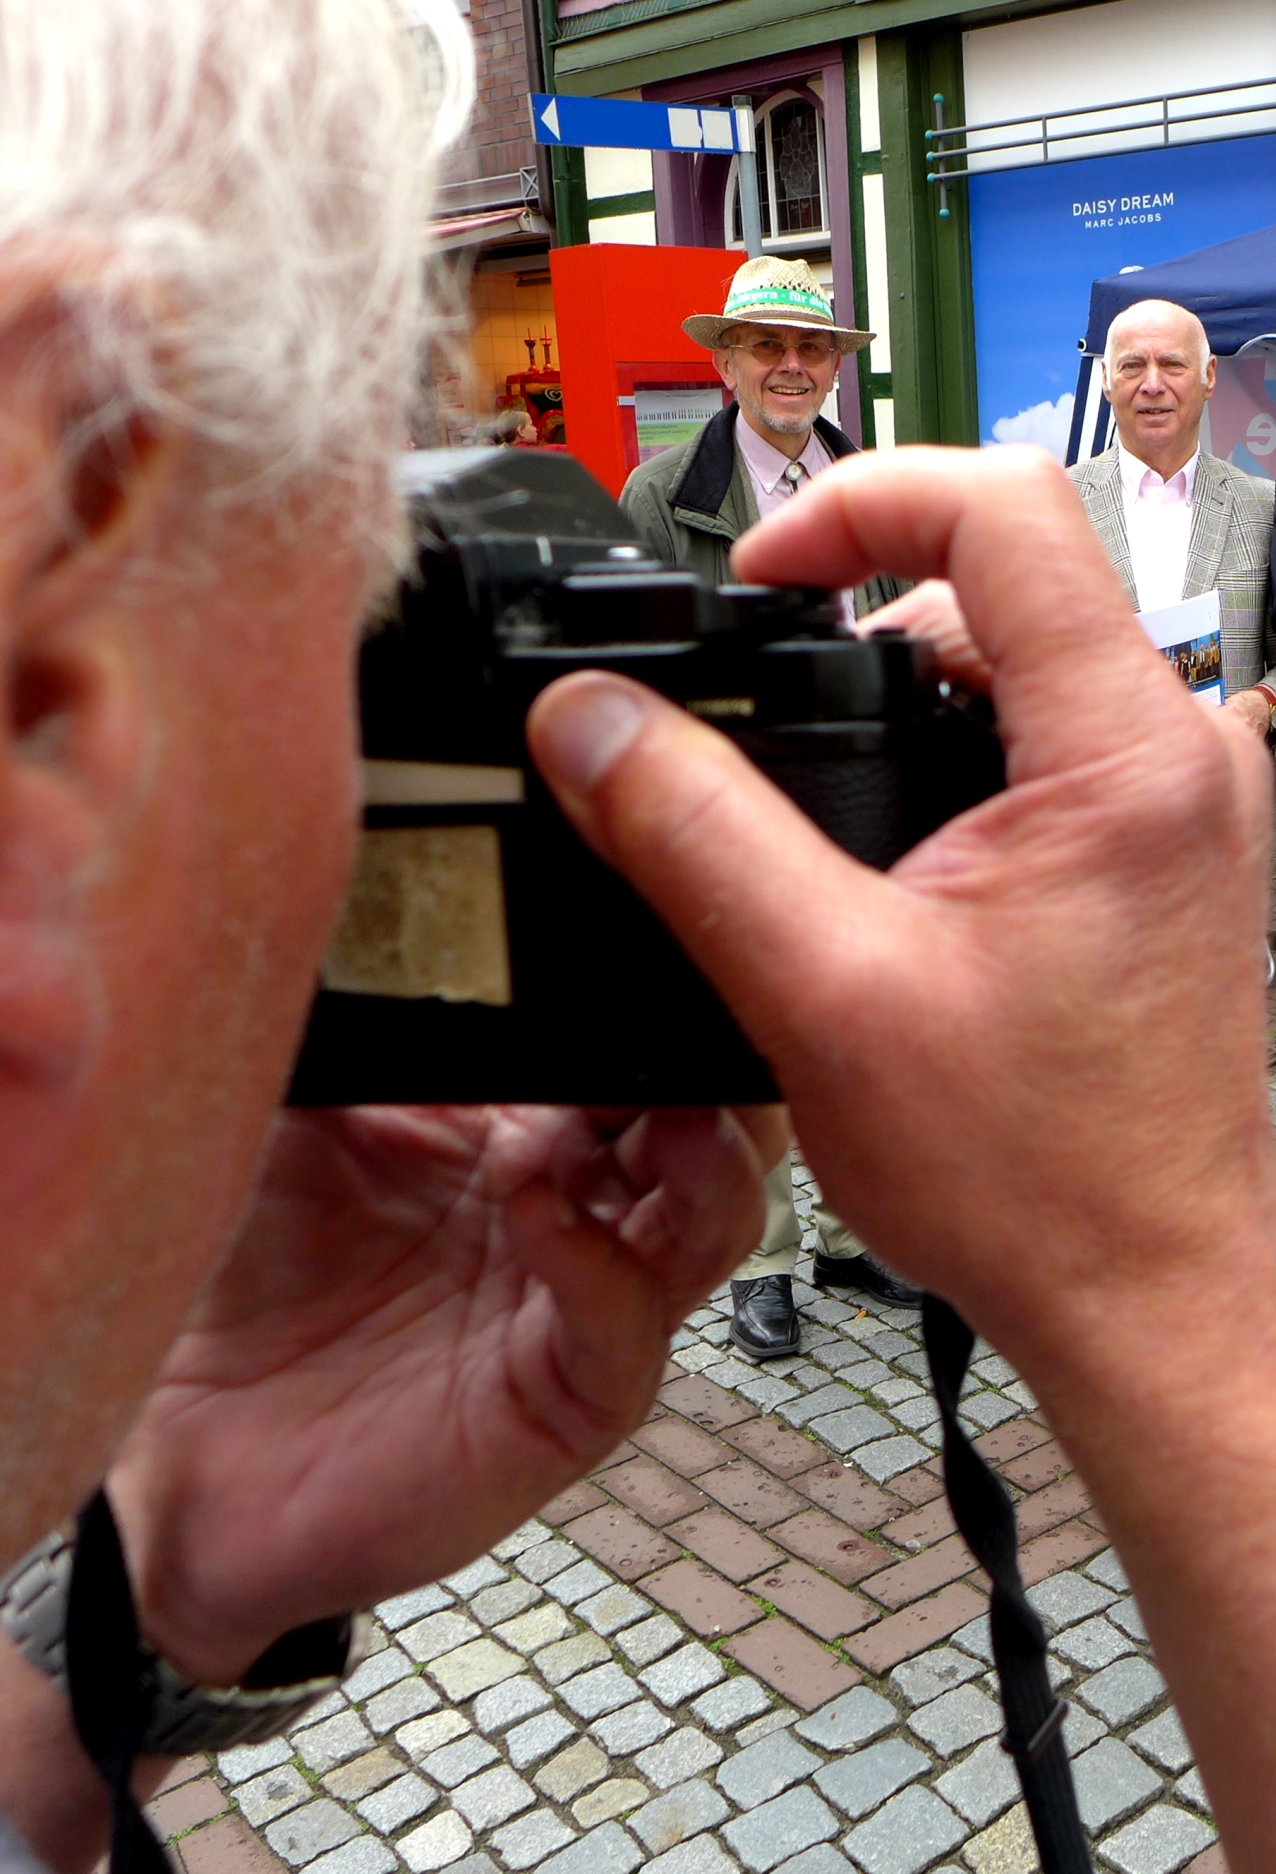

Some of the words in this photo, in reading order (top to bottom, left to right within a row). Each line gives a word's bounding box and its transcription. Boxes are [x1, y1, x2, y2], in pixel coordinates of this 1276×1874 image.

[1072, 199, 1117, 216] DAISY
[1121, 192, 1174, 211] DREAM
[1085, 218, 1114, 229] MARC
[1118, 213, 1161, 226] JACOBS
